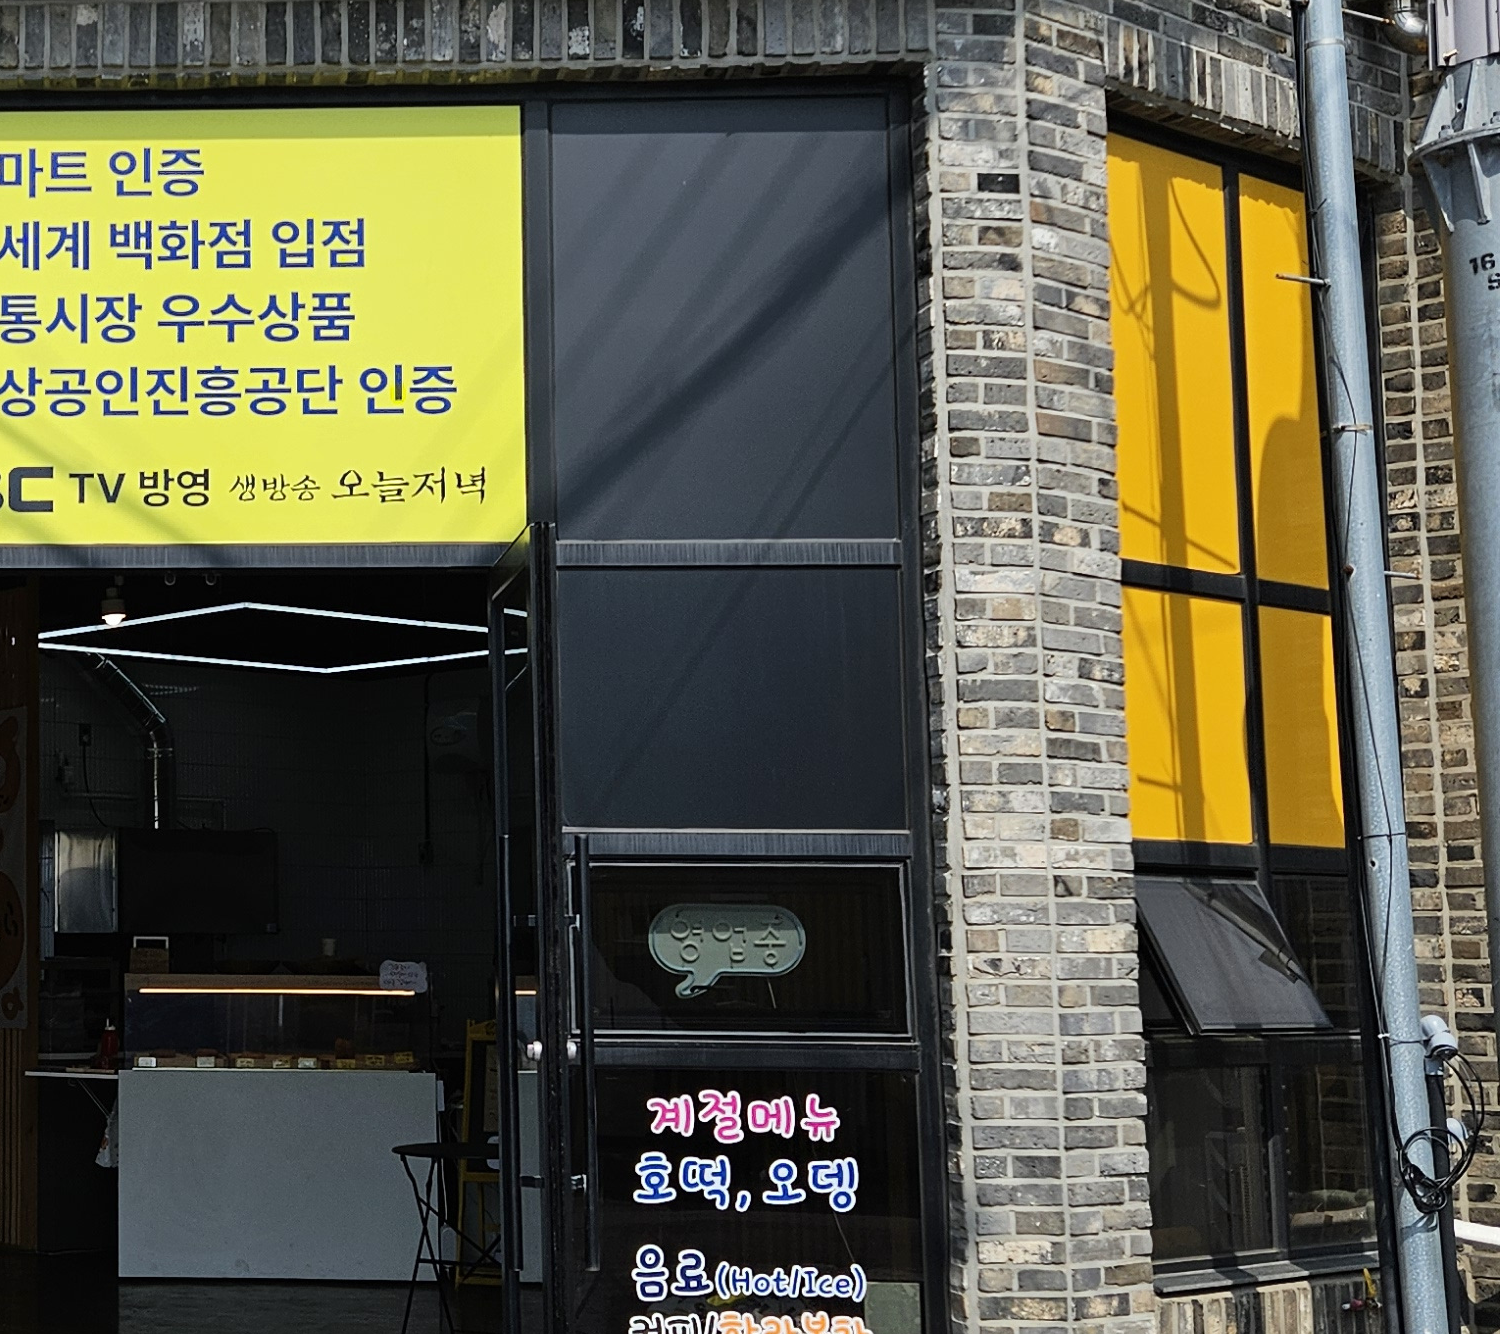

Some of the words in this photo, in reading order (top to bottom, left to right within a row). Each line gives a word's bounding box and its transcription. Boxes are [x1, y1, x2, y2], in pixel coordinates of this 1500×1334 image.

[108, 148, 205, 197] 인증
[109, 219, 252, 270] 백화점
[271, 218, 365, 268] 입점
[157, 291, 356, 343] 우수상품
[359, 364, 458, 415] 인증
[68, 472, 126, 504] TV
[139, 468, 210, 507] 방영
[229, 473, 321, 502] 생방송
[331, 466, 486, 504] 오늘저녁
[671, 918, 788, 966] 영업중
[647, 1089, 841, 1144] 계절메뉴
[633, 1152, 752, 1213] 호떡,
[762, 1156, 859, 1213] 오뎅
